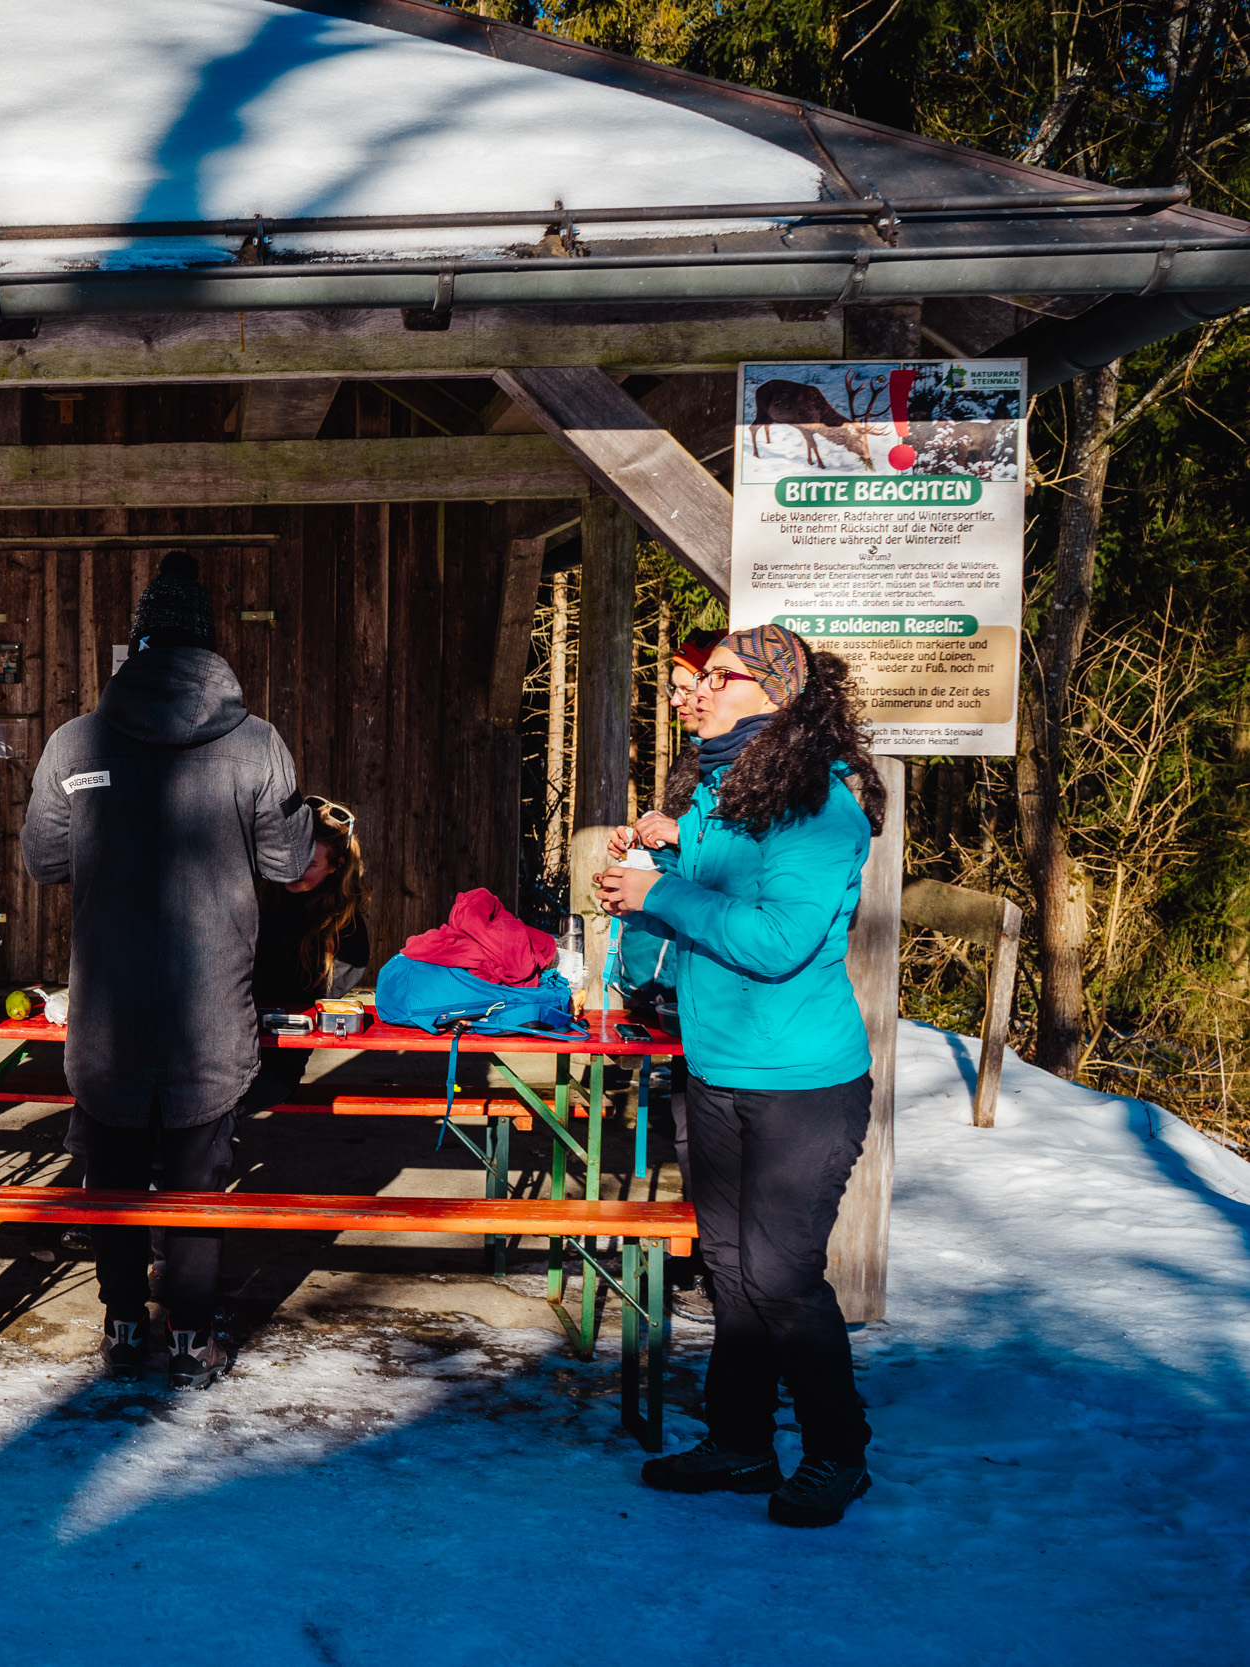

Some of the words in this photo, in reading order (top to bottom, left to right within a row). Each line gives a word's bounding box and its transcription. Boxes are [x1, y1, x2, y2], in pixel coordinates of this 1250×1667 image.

[786, 481, 848, 502] BITTE
[854, 480, 971, 500] BEACHTEN
[761, 512, 787, 522] Liebe
[790, 512, 840, 522] Wanderer,
[844, 511, 894, 522] Radfahrer
[898, 511, 915, 521] und
[919, 511, 995, 522] Wintersportler,
[781, 524, 803, 534] bitte
[806, 524, 837, 534] nehmt
[841, 522, 888, 533] Rücksicht
[893, 523, 908, 533] auf
[912, 523, 926, 532] die
[930, 522, 953, 532] Nöte
[957, 523, 974, 532] der
[792, 535, 837, 545] Wildtiere
[840, 535, 882, 544] während
[886, 535, 902, 544] der
[905, 534, 960, 544] Winterzeit!
[898, 562, 944, 570] verschreckt
[947, 562, 958, 570] die
[961, 562, 998, 570] Wildtiere.
[752, 572, 766, 580] Zur
[768, 572, 810, 580] Einsparung
[829, 572, 893, 580] Energiereserven
[950, 571, 984, 579] während
[987, 571, 1000, 579] des
[752, 581, 784, 589] Winters.
[787, 581, 816, 589] Werden
[814, 590, 850, 598] wertvolle
[852, 590, 881, 598] Energie
[784, 618, 810, 633] Die
[815, 618, 825, 633] 3
[830, 618, 900, 633] goldenen
[904, 618, 964, 633] Regeln:
[817, 640, 840, 649] bitte
[844, 640, 912, 649] ausschließlich
[916, 640, 966, 649] markierte
[969, 639, 988, 649] und
[870, 652, 914, 660] Radwege
[918, 652, 936, 660] und
[878, 663, 908, 672] weder
[911, 664, 922, 672] zu
[951, 663, 974, 672] noch
[978, 663, 994, 672] mit
[919, 688, 928, 696] in
[931, 688, 946, 696] die
[949, 687, 968, 696] Zeit
[972, 687, 990, 696] des
[872, 698, 932, 708] Dämmerung
[936, 699, 953, 708] und
[957, 699, 981, 708] auch
[902, 728, 942, 736] Naturpark
[944, 728, 983, 736] Steinwald
[928, 737, 959, 745] Heimat!
